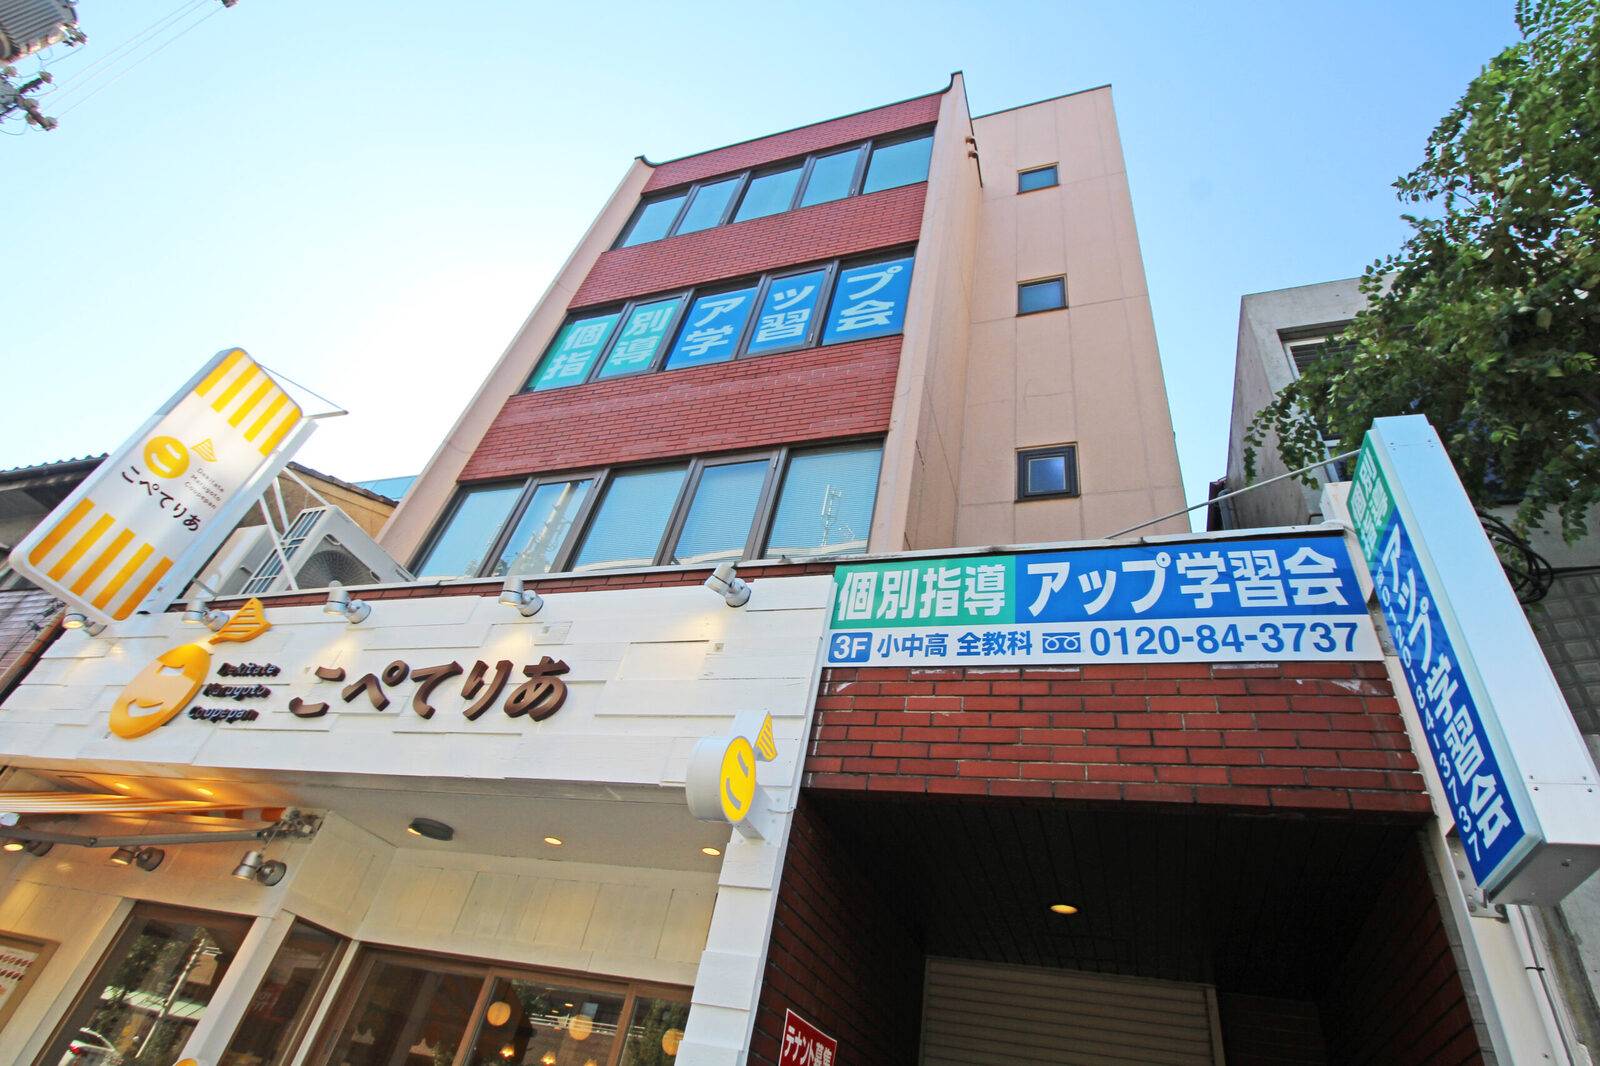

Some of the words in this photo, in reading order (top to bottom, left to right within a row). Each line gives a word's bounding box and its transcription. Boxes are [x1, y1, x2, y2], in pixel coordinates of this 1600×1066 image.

[121, 465, 201, 532] こぺてりあ
[837, 564, 1007, 622] 個別指導
[1027, 546, 1350, 617] アップ学習会
[831, 633, 869, 660] 3F
[876, 632, 949, 658] 小中高
[956, 630, 1033, 657] 全教科
[1090, 622, 1358, 656] 0120-84-3737
[288, 655, 570, 722] こぺてりあ
[1381, 522, 1512, 850] アップ学習会
[1380, 584, 1482, 862] 0120-84-3737
